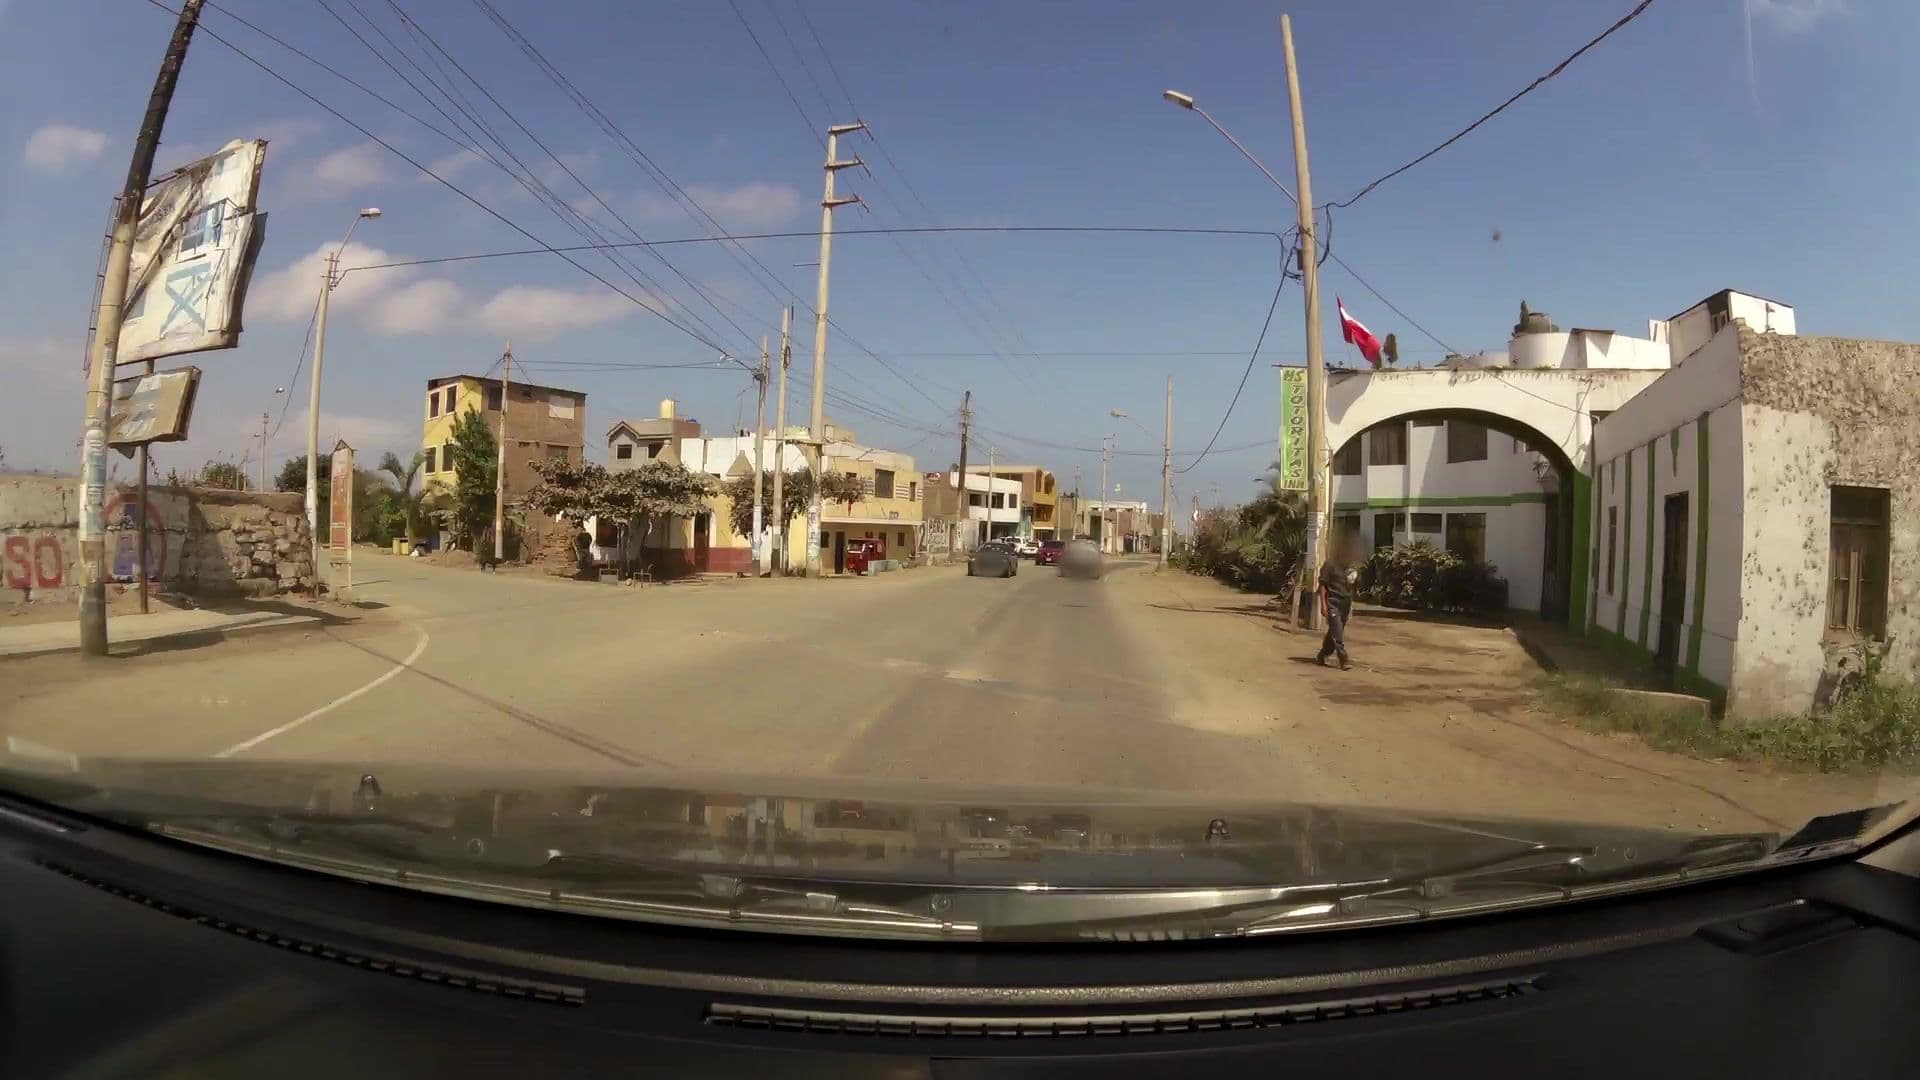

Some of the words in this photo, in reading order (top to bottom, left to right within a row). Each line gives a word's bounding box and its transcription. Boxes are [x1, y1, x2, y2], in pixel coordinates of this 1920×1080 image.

[1289, 384, 1305, 478] TOTORITAS
[1284, 480, 1305, 489] INN
[5, 536, 63, 588] SO
